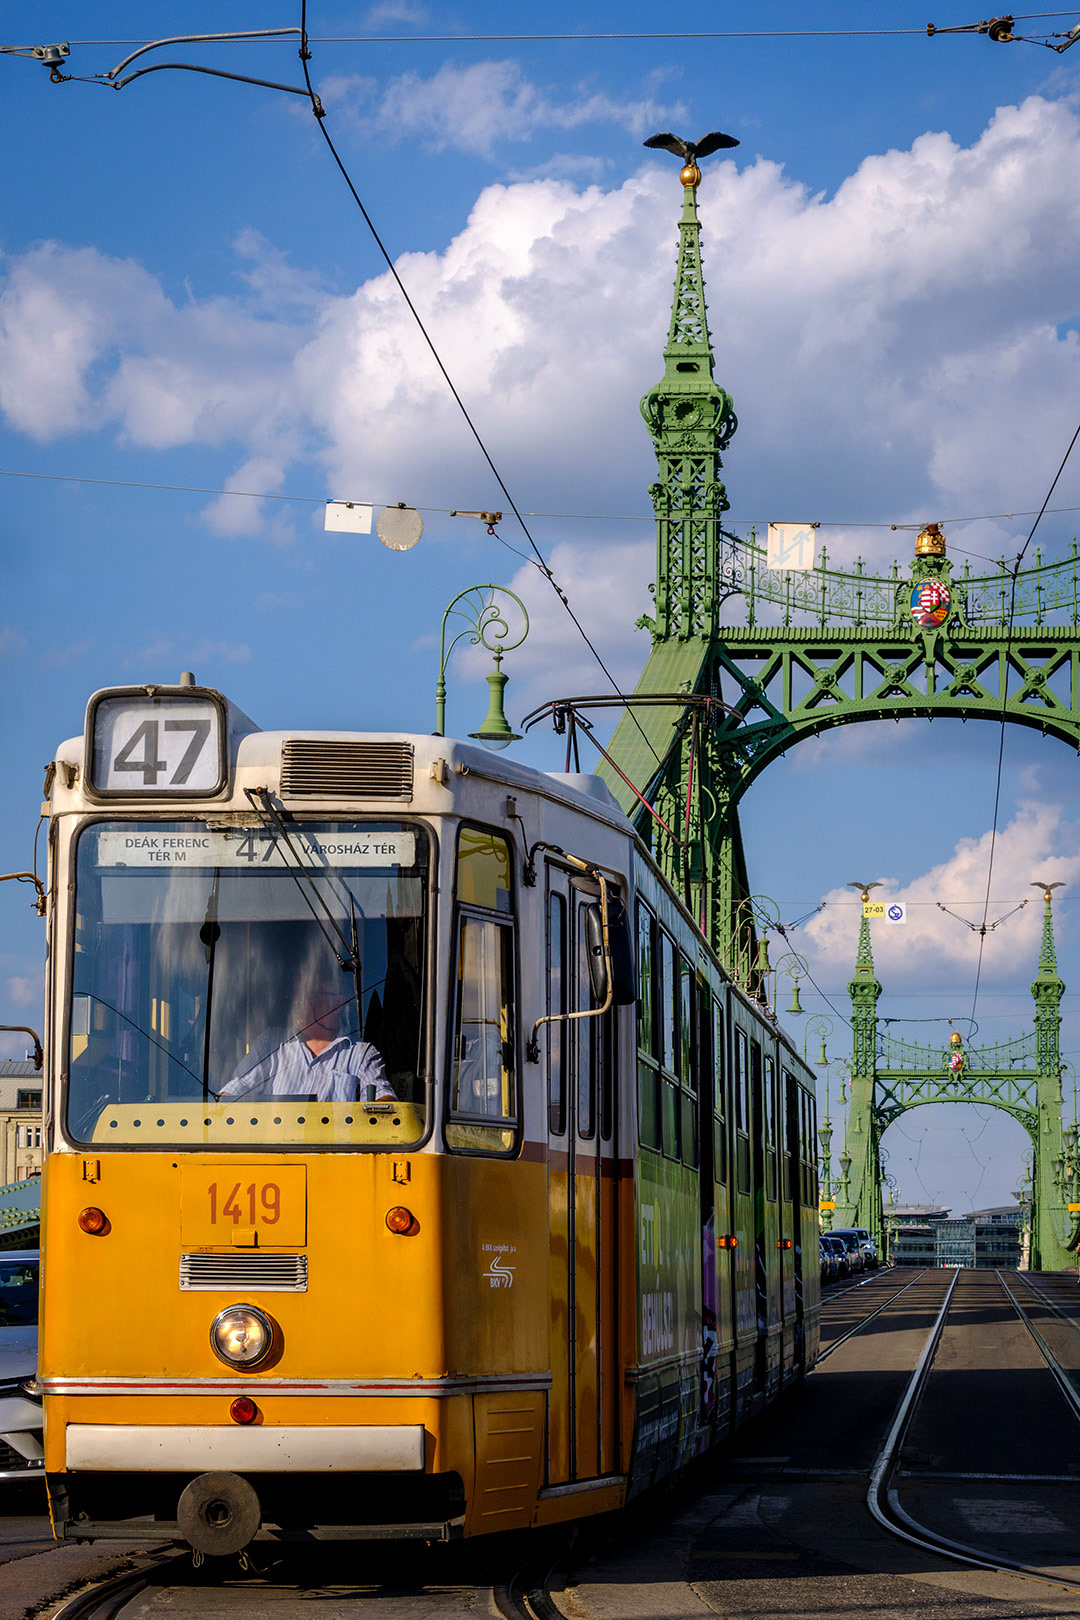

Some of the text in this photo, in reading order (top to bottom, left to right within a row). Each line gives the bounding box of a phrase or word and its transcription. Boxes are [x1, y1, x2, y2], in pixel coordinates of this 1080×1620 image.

[113, 719, 212, 785] 47
[125, 836, 210, 848] DEÁK FERENC
[301, 842, 396, 854] VÁROSHÁZ TÉR
[148, 849, 186, 861] TÉR M
[235, 836, 279, 862] 47
[864, 906, 884, 914] 27-03
[208, 1183, 280, 1225] 1419
[490, 1277, 501, 1288] BKV
